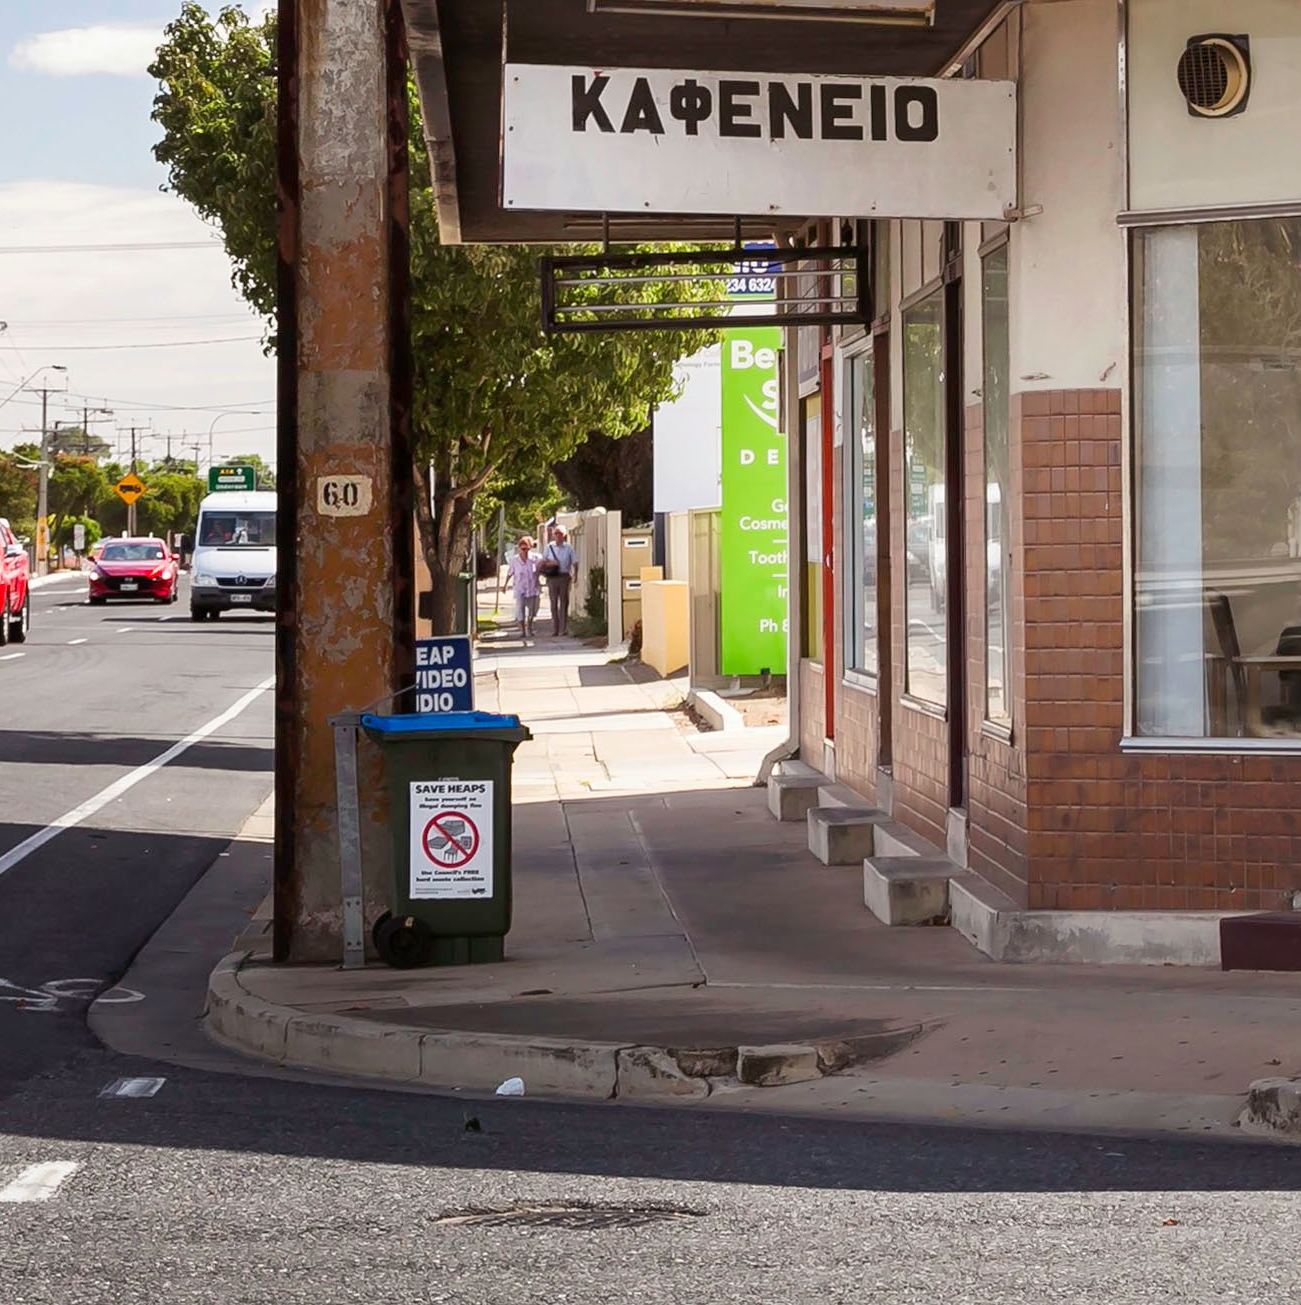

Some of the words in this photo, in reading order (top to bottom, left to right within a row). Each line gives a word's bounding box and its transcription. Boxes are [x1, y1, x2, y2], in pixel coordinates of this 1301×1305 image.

[731, 339, 776, 370] Be
[739, 516, 788, 531] Cosme
[748, 550, 788, 565] Tooth
[759, 619, 778, 633] Ph
[416, 645, 455, 666] EAP
[416, 692, 454, 712] DIO
[415, 784, 446, 794] SAVE
[448, 784, 486, 794] HEAPS
